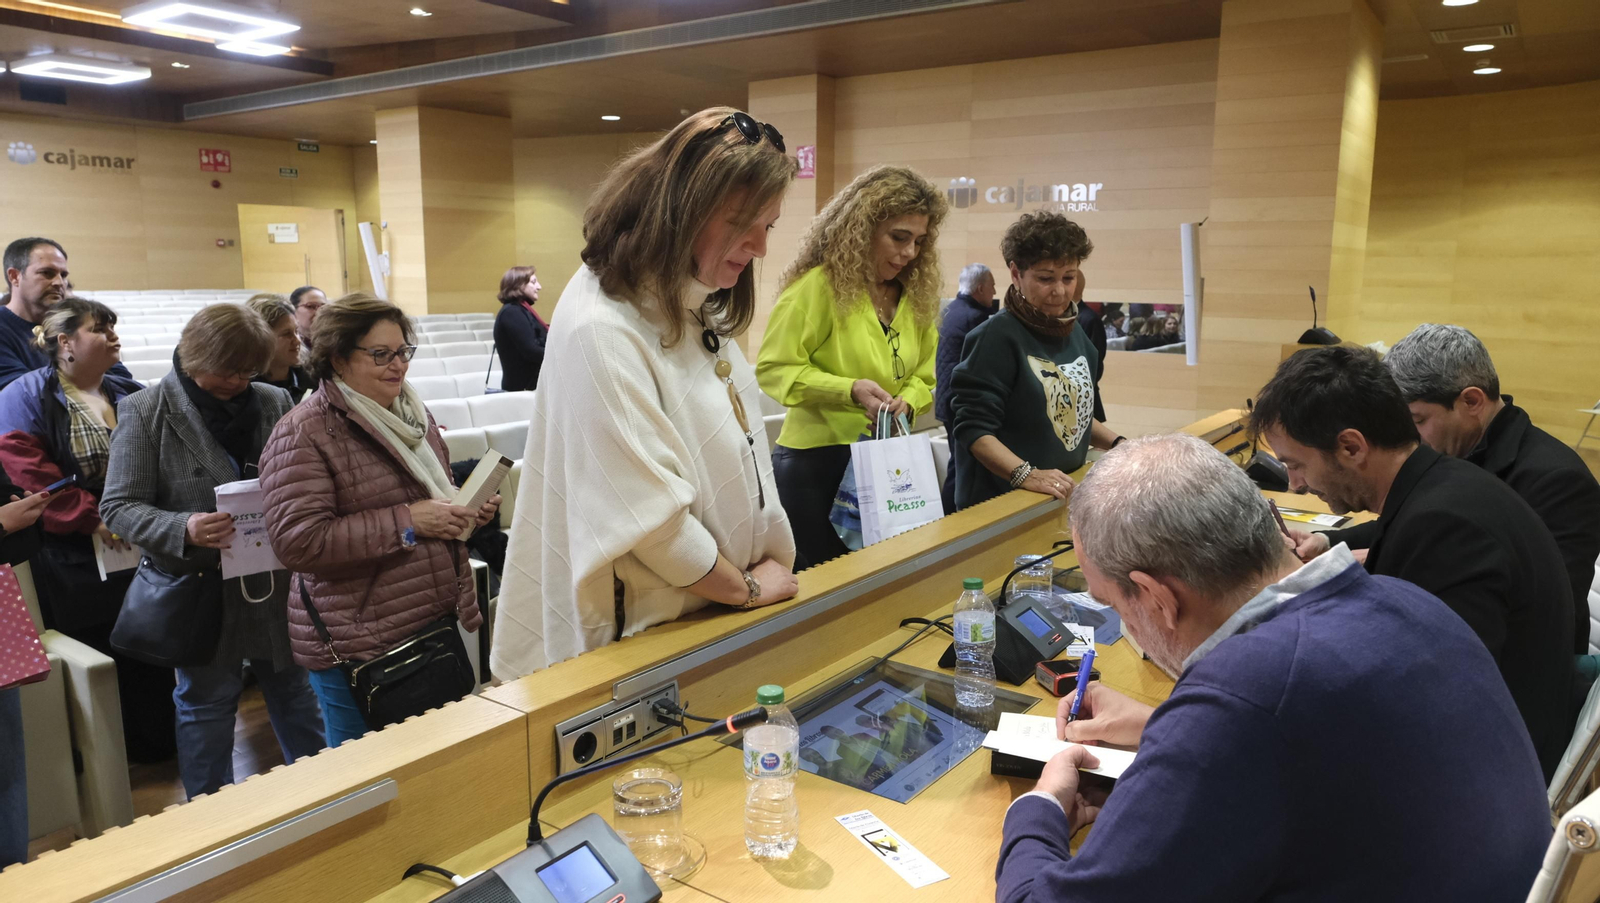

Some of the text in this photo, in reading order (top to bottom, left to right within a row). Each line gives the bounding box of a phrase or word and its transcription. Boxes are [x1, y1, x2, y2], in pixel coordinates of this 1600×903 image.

[43, 148, 136, 170] cajamar
[985, 178, 1103, 211] cajamar
[1067, 202, 1099, 212] RURAL
[886, 500, 926, 513] Picasso
[234, 512, 263, 520] casso
